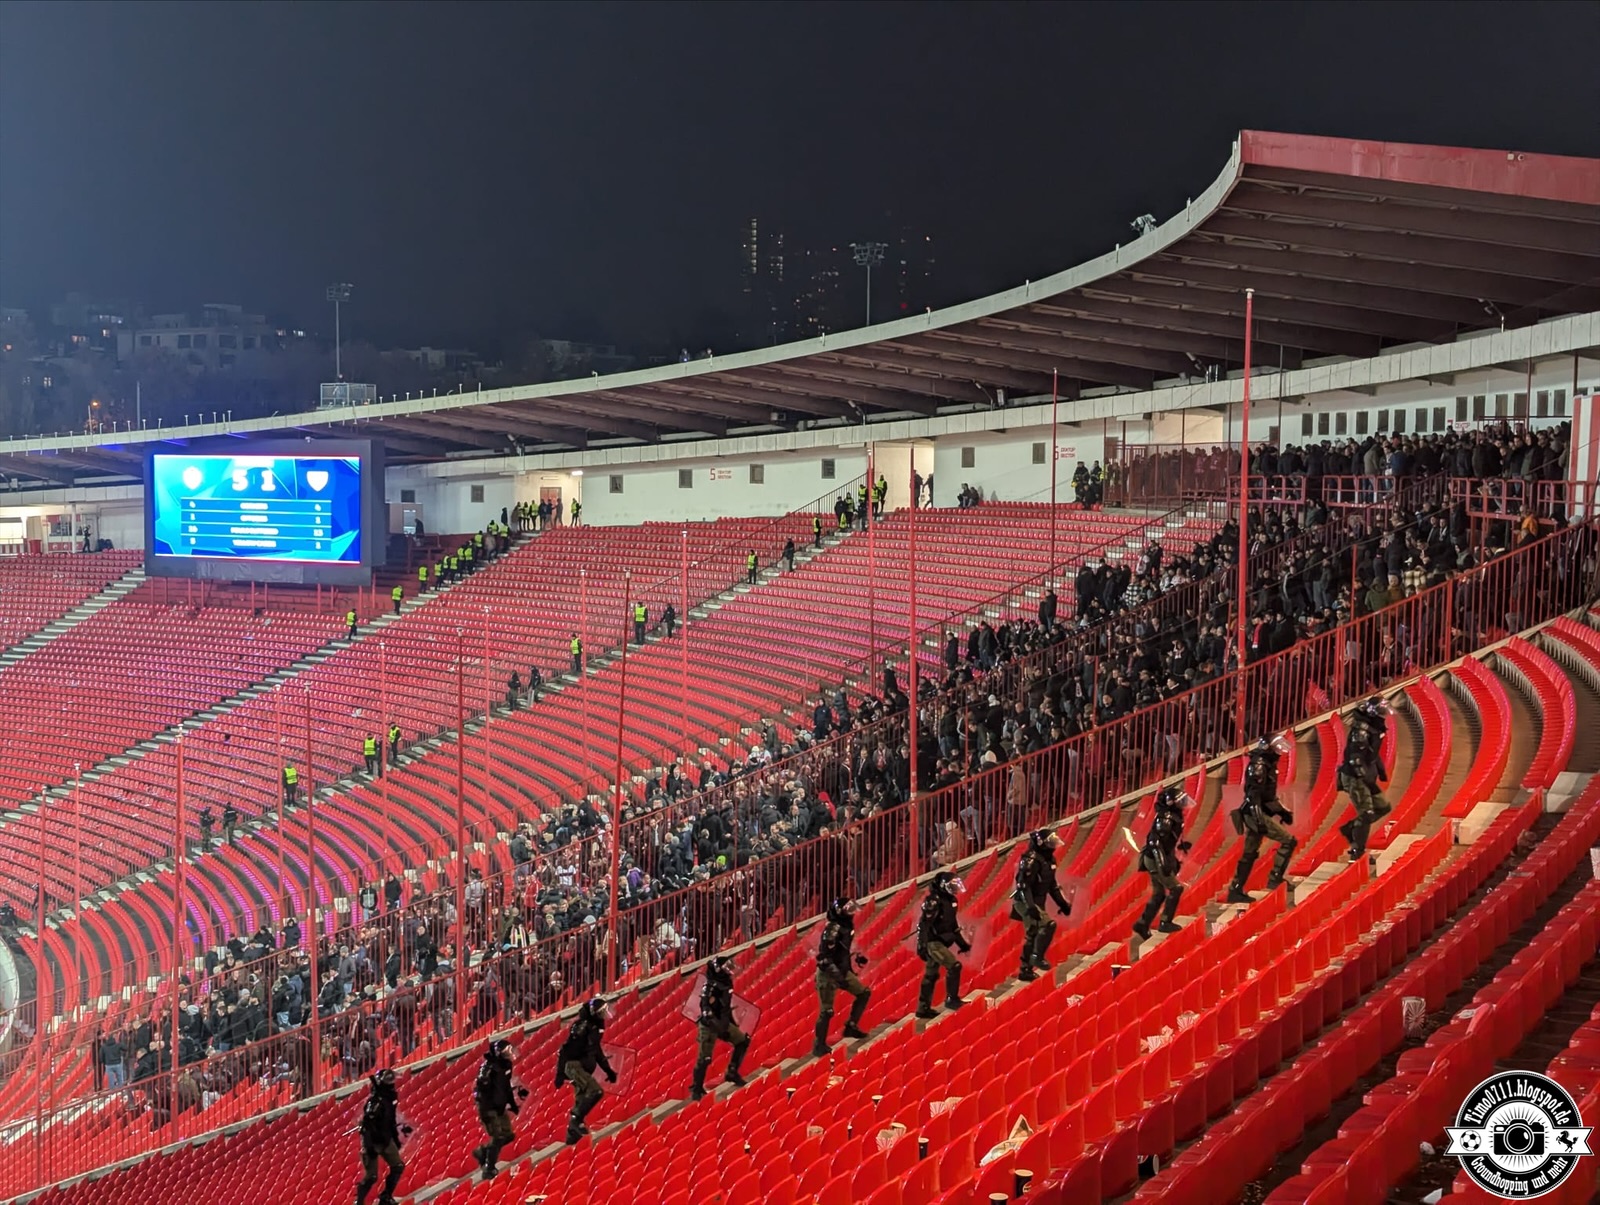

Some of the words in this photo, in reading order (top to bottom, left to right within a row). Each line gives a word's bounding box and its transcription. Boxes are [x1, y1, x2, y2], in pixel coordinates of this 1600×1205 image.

[232, 468, 249, 491] 5
[261, 469, 276, 491] 1
[709, 467, 716, 481] 5
